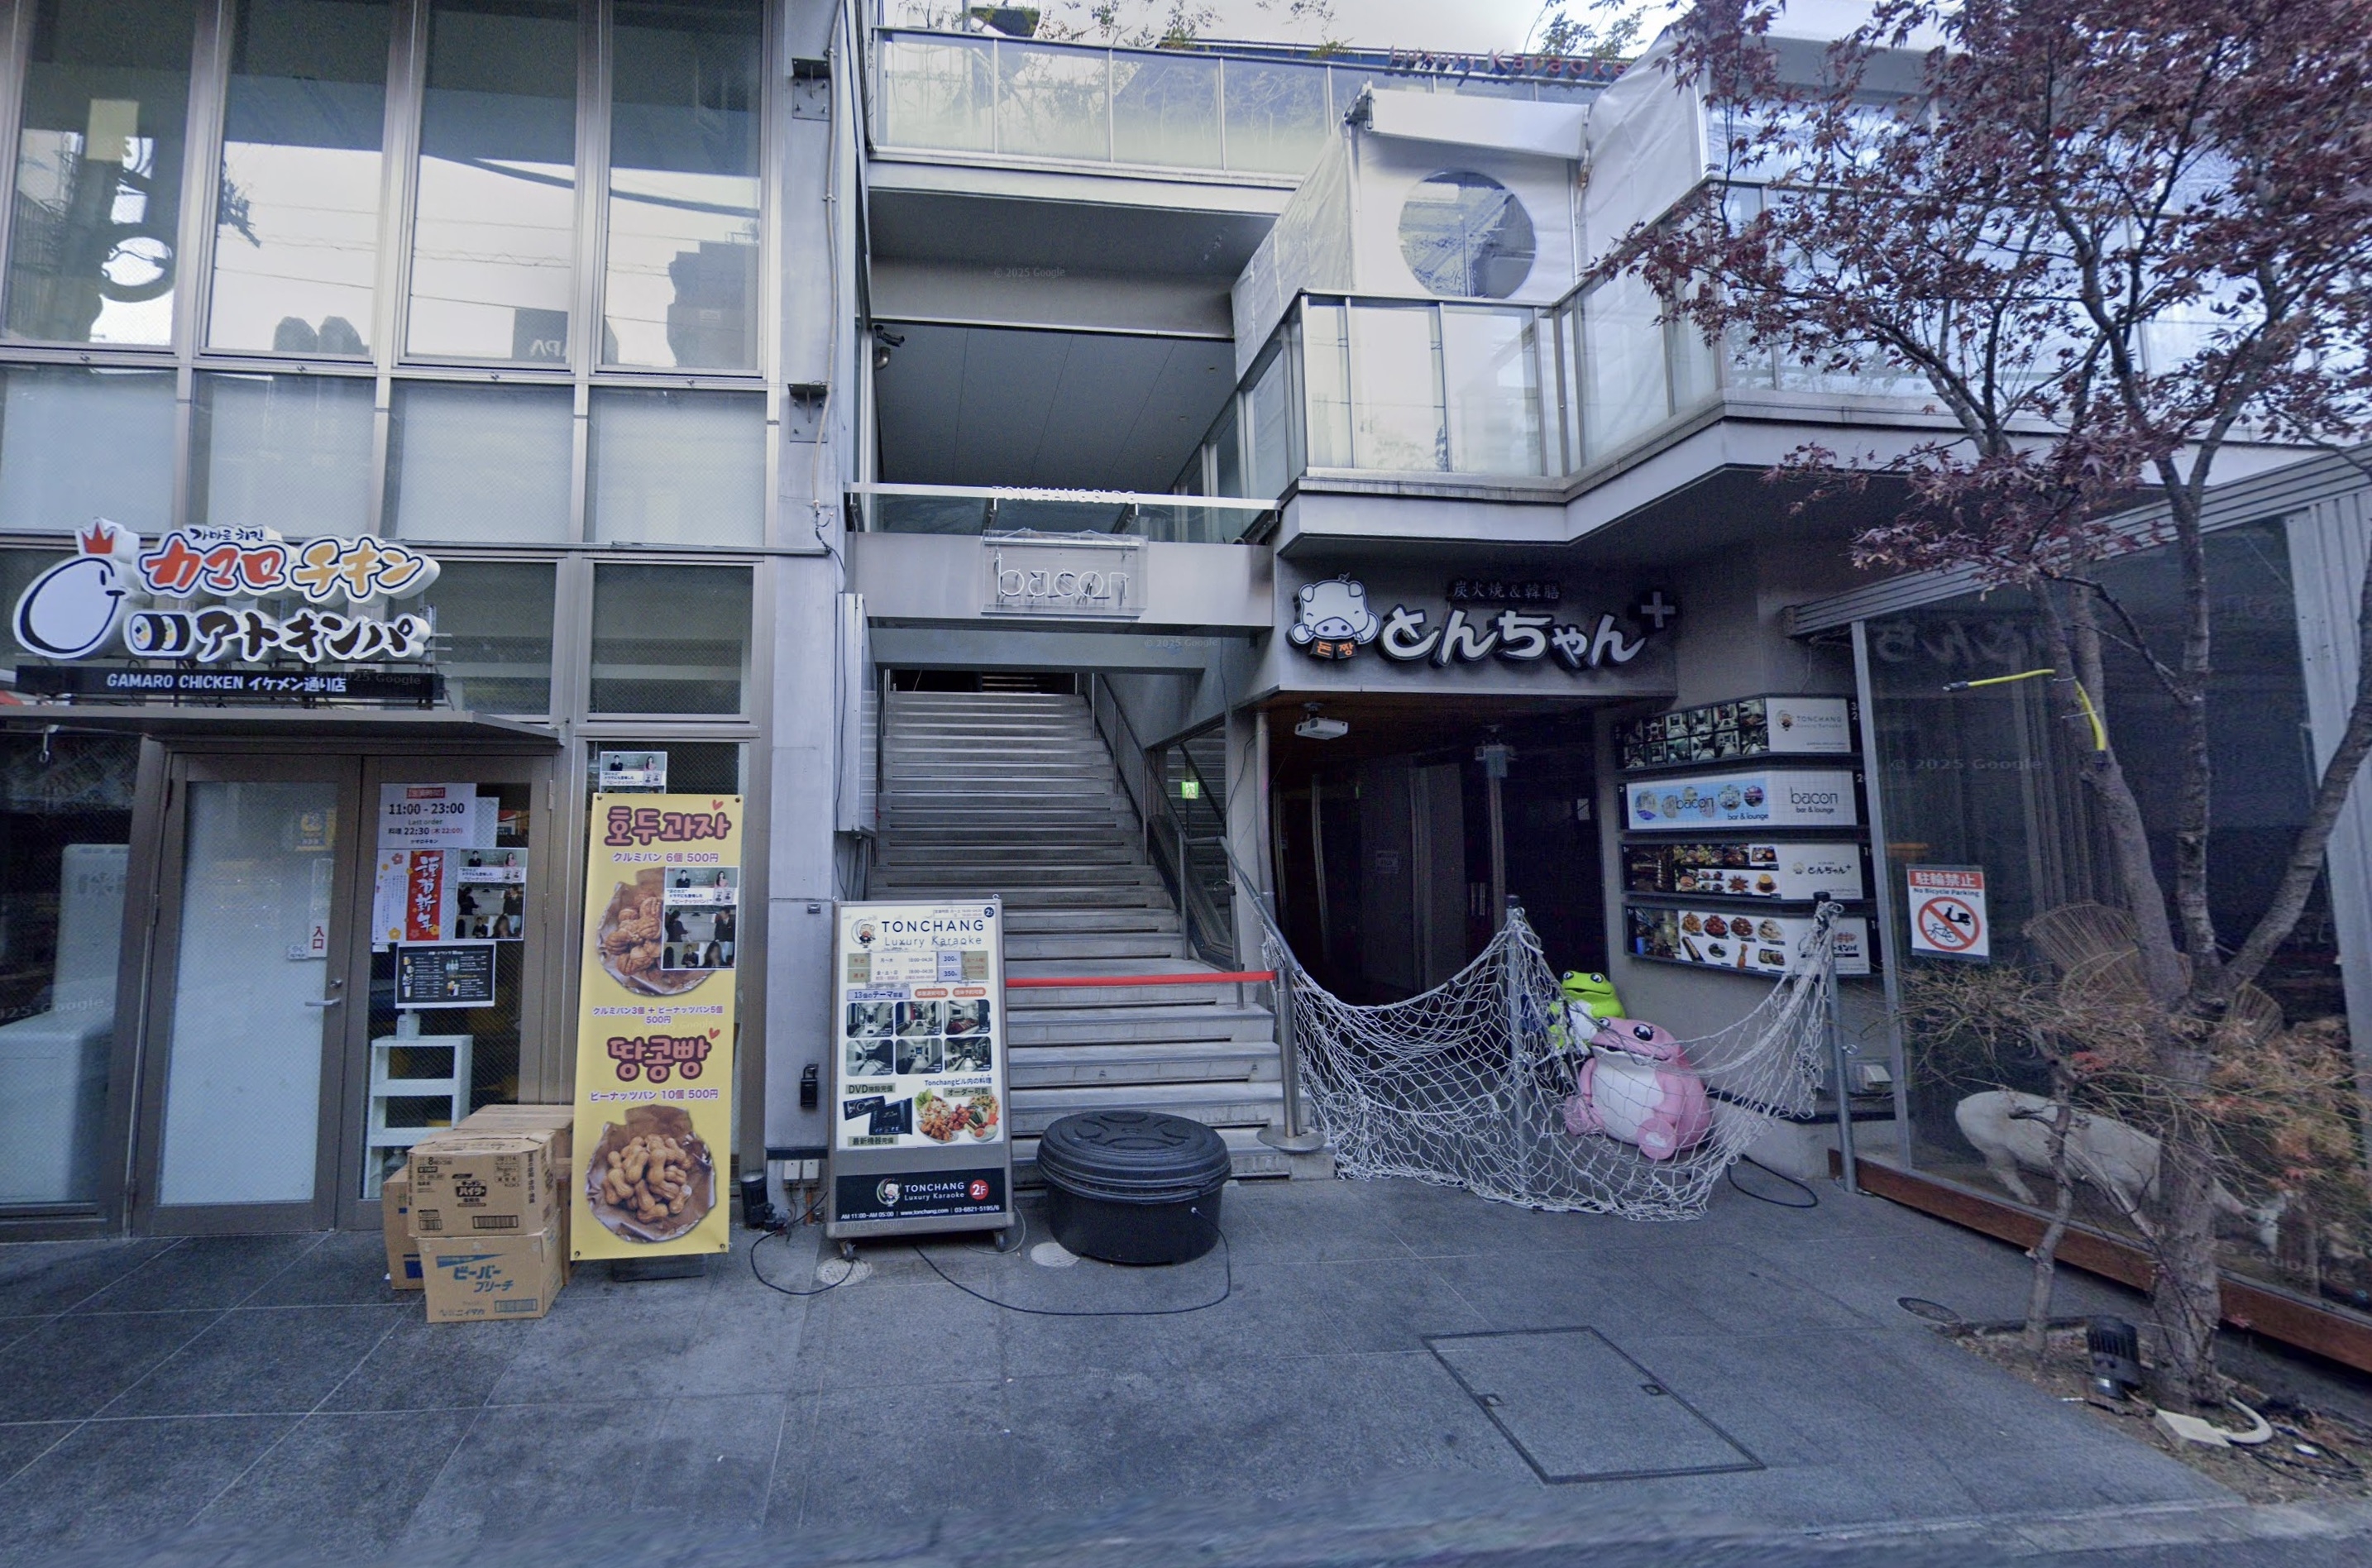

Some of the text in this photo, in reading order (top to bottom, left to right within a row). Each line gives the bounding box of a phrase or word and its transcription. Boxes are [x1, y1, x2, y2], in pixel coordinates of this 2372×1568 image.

[1488, 48, 1628, 79] Karaoke
[997, 552, 1127, 599] bacon
[1383, 605, 1647, 668] とんちゃん
[107, 673, 347, 693] GAMARO CHICKEN イケメン通り店
[1789, 786, 1839, 805] bacon
[389, 803, 421, 815] 11:00
[431, 802, 466, 815] 23:00
[1676, 795, 1714, 810] bacon
[1727, 812, 1738, 820] bar
[1747, 812, 1769, 822] lounge
[1814, 806, 1835, 815] lounge
[404, 827, 429, 835] 22:30
[605, 805, 732, 847] 호두과자
[613, 852, 662, 863] クルミパン
[686, 853, 719, 863] 500円
[1915, 872, 1977, 887] 駐輪禁止
[1951, 889, 1981, 897] Parking
[881, 919, 984, 933] TONCHANG
[313, 925, 324, 950] 入口
[885, 935, 982, 949] Luxury Karaoke
[646, 1016, 672, 1024] 500円
[607, 1035, 712, 1083] 땅콩빵
[925, 1077, 992, 1088] Tonchangビル内の料理
[688, 1089, 719, 1099] 500円
[947, 1087, 988, 1096] オーダー可能
[904, 1182, 965, 1193] TONCHANG
[972, 1183, 987, 1196] 2F
[904, 1192, 965, 1202] Luxury Karaoke
[901, 1207, 949, 1217] www.tonchang.com
[954, 1205, 1000, 1213] 03-6821-5195/6
[453, 1264, 501, 1280] ビーバー
